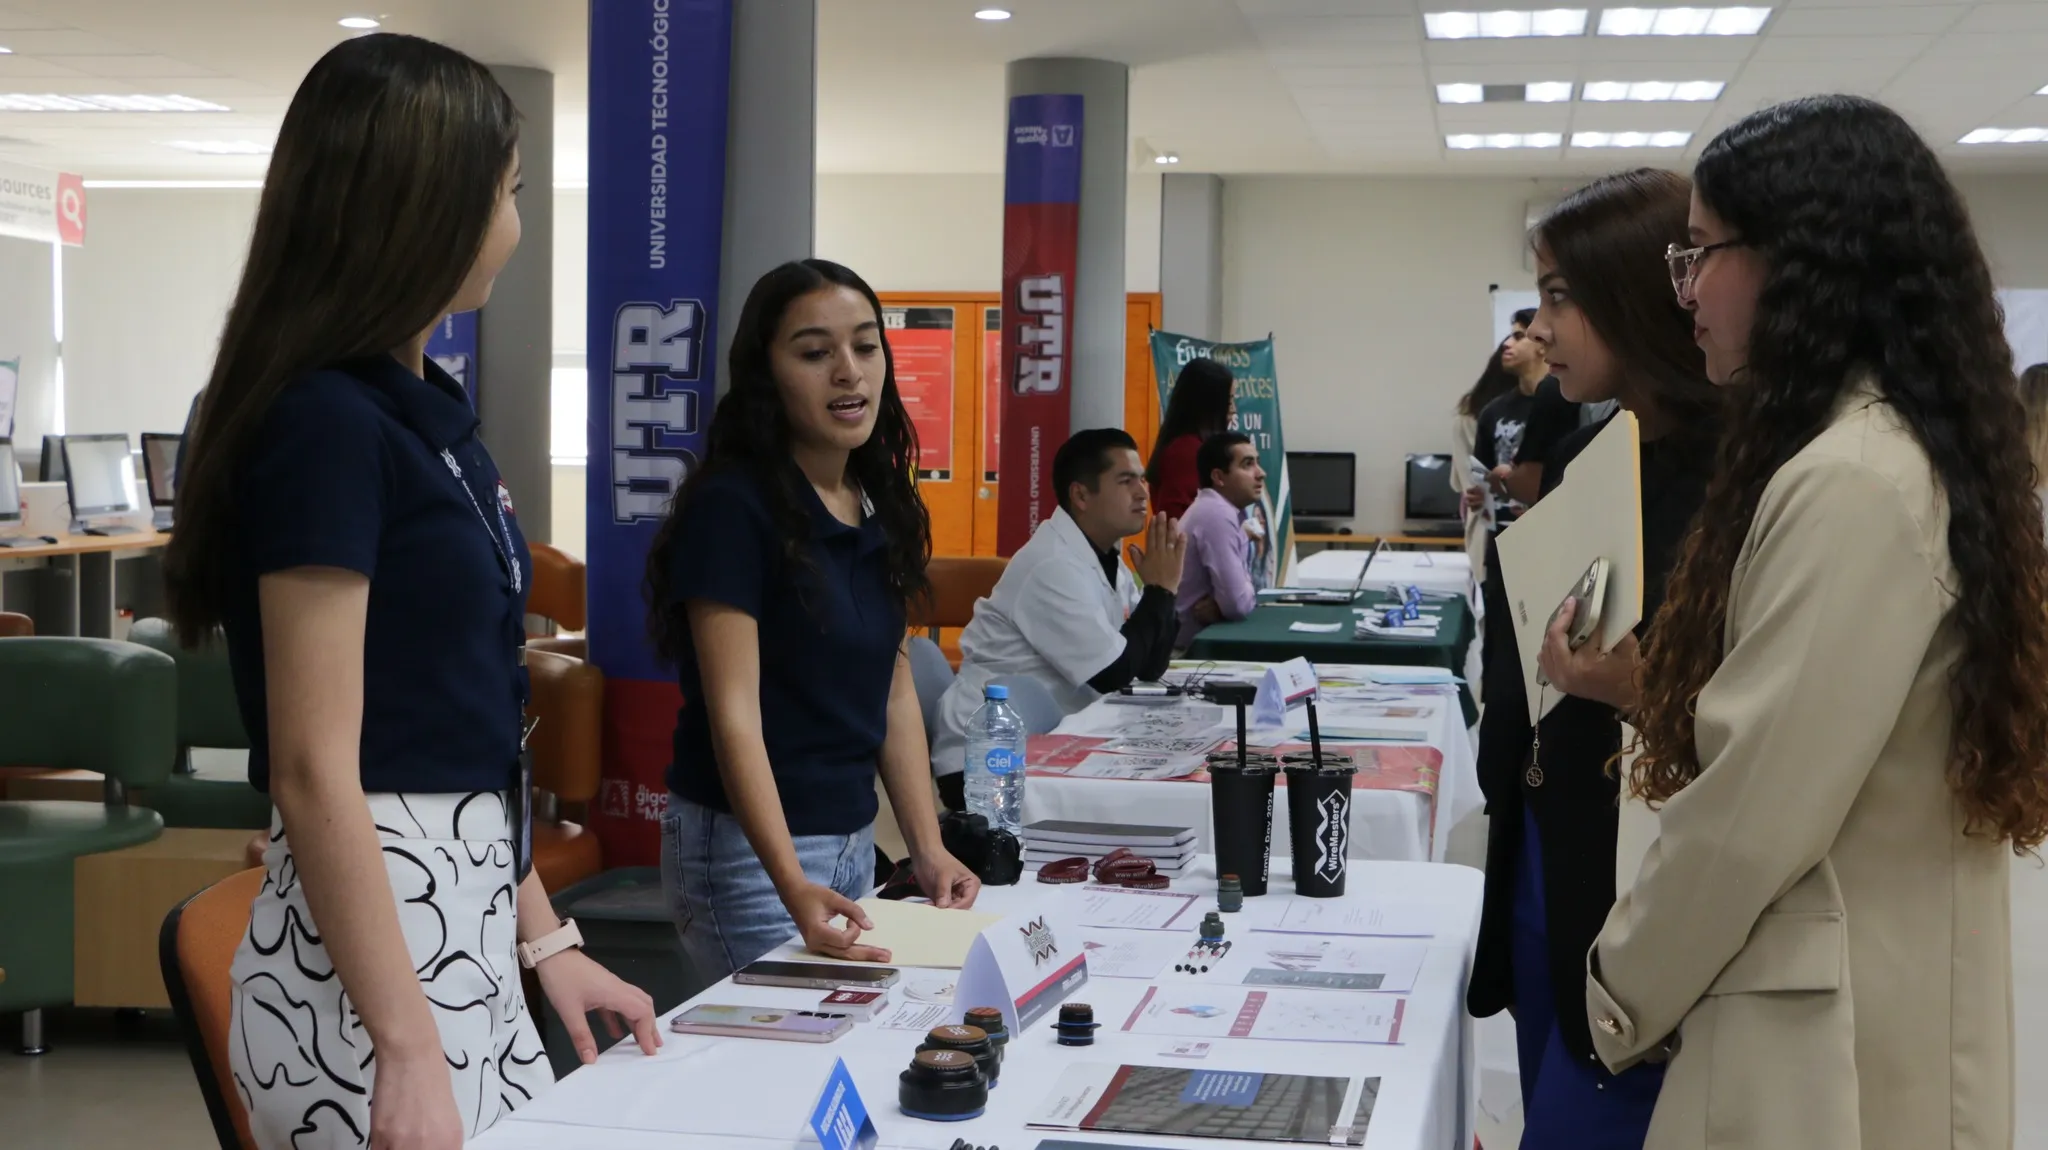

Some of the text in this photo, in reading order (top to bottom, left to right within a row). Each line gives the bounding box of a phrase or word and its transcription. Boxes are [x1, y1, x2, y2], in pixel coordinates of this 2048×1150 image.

[650, 134, 668, 268] UNIVERSIDAD
[1015, 274, 1063, 395] UTR
[611, 300, 704, 524] UTR
[1244, 413, 1262, 430] UN
[1030, 426, 1040, 498] UNIVERSIDAD
[1260, 433, 1271, 449] TI
[987, 753, 1011, 768] ciel
[1261, 846, 1270, 882] Family
